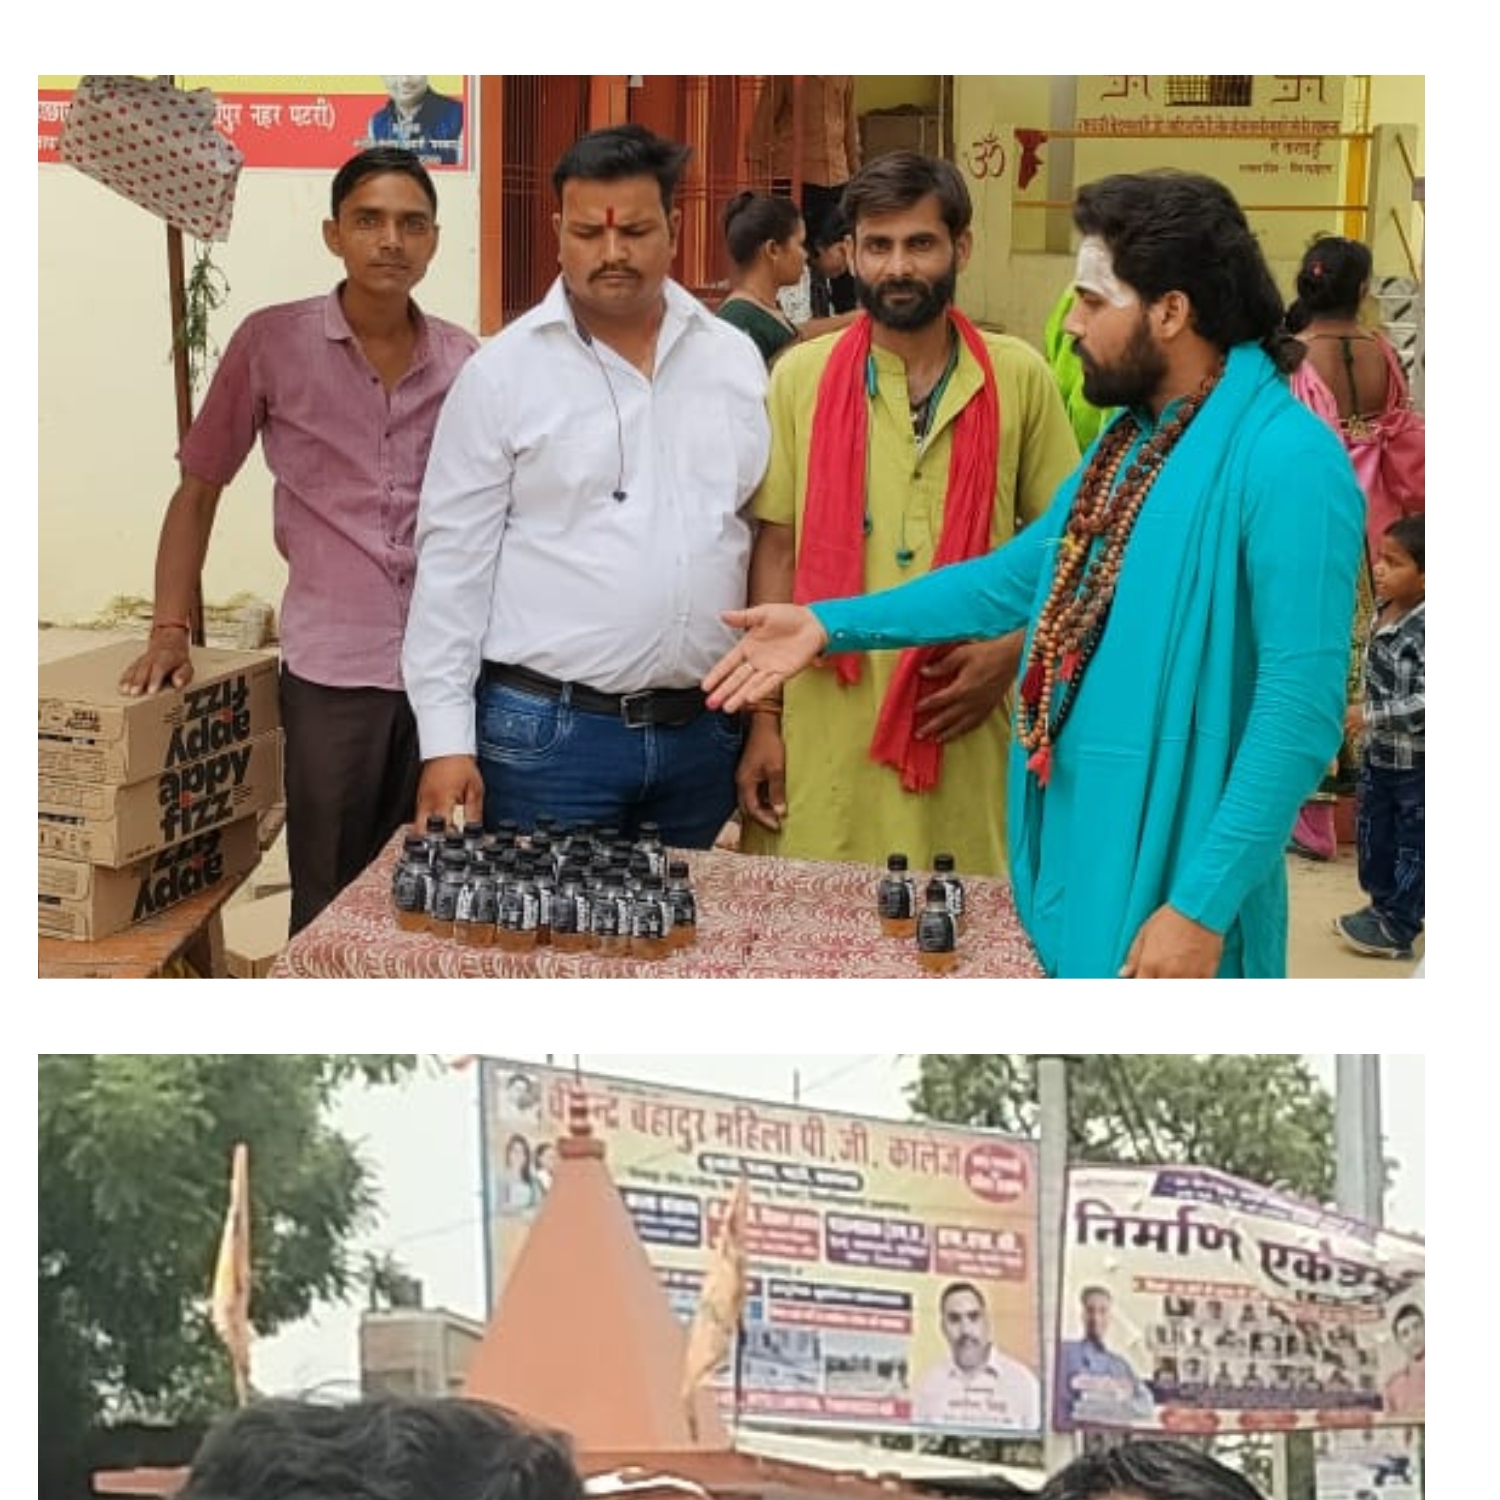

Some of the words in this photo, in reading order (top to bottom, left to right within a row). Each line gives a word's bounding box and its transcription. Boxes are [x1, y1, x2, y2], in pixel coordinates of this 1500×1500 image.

[251, 104, 282, 128] नहर
[183, 675, 249, 721] fizz
[164, 709, 251, 769] appy
[159, 744, 252, 808] appy
[159, 789, 234, 842] fizz
[131, 852, 223, 921] appy
[631, 1098, 706, 1154] बहादुर
[715, 1103, 792, 1156] महिला
[888, 1133, 962, 1181] कालेज
[1076, 1198, 1242, 1262] निर्माण
